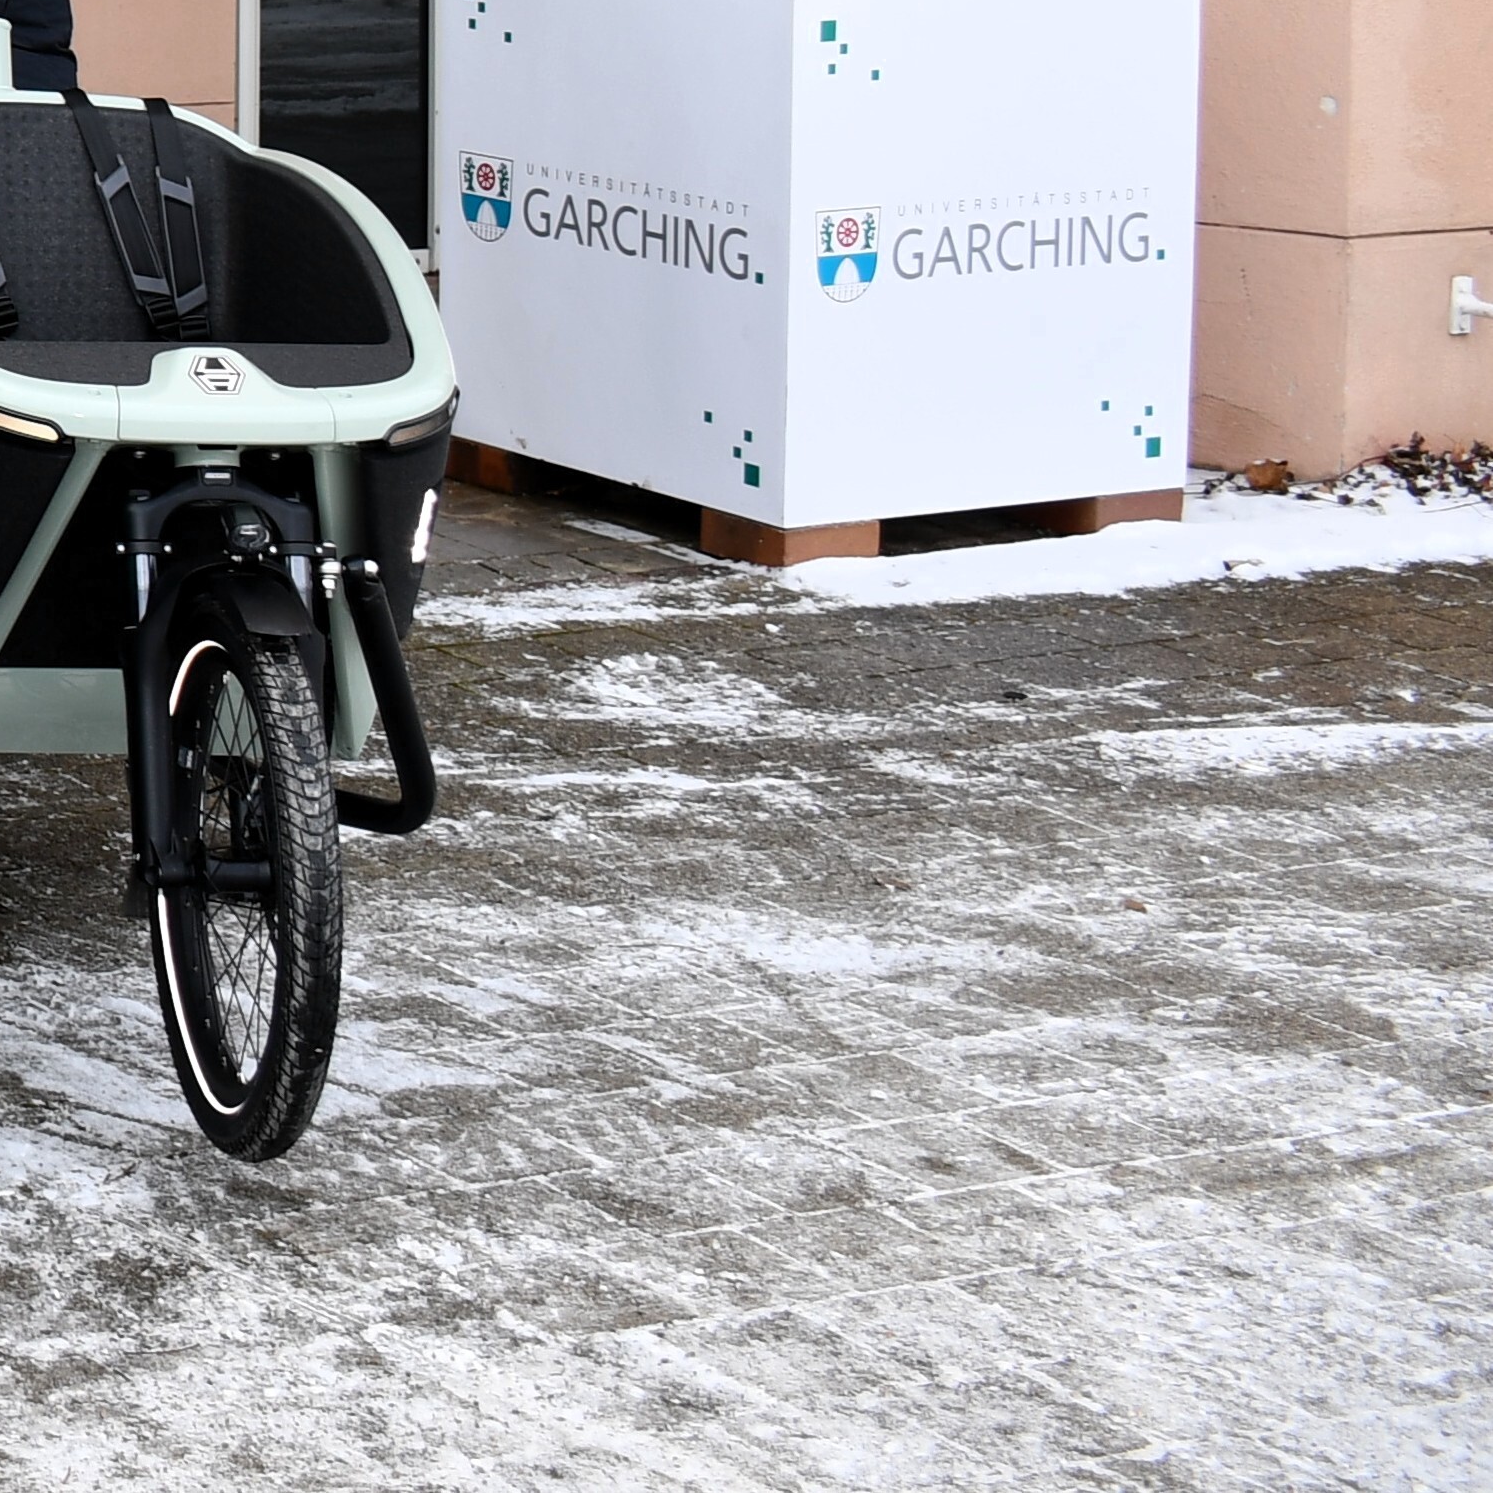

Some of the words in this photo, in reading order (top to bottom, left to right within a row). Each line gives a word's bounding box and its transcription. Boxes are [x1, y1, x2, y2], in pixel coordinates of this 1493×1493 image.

[526, 162, 750, 217] UNIVERSITÄTSSTADT
[522, 187, 764, 285] GARCHING.
[892, 211, 1166, 281] GARCHING.
